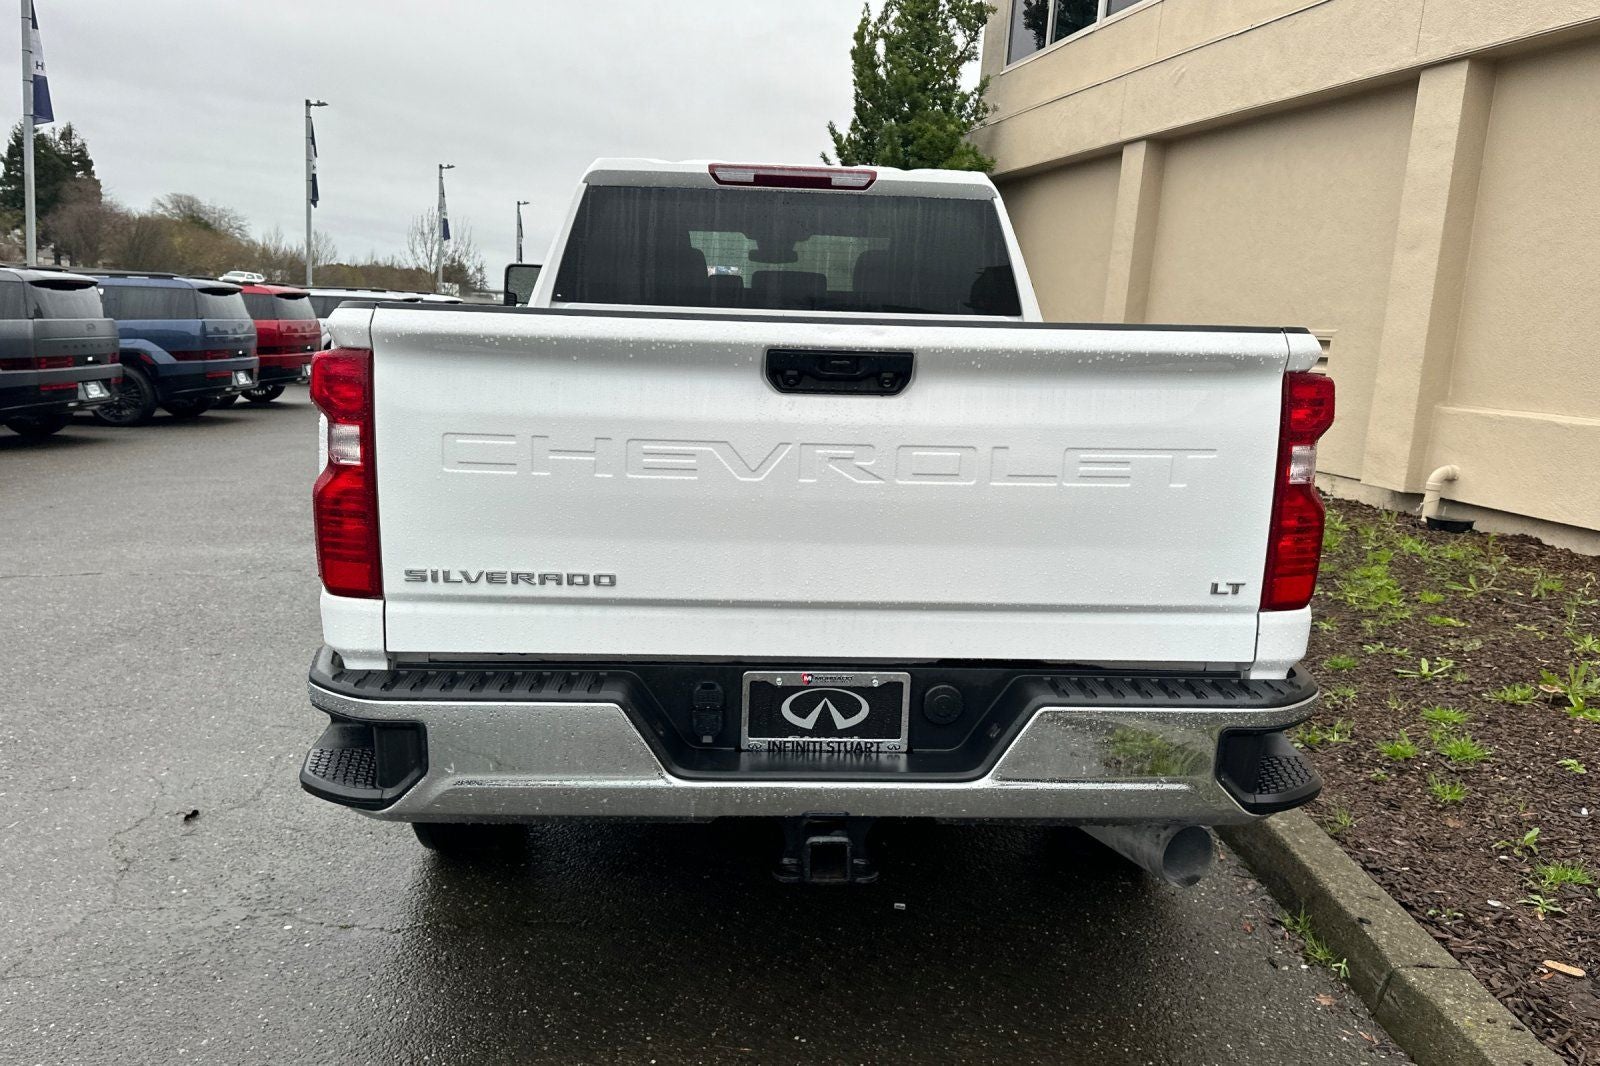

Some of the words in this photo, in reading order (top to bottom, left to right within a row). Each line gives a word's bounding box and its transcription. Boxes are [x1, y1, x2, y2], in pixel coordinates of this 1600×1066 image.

[441, 431, 1218, 489] CHEVROLET
[404, 568, 617, 587] SILVERADO
[1210, 582, 1247, 595] LT
[767, 740, 823, 752] INFINITI
[827, 741, 884, 753] STUART
